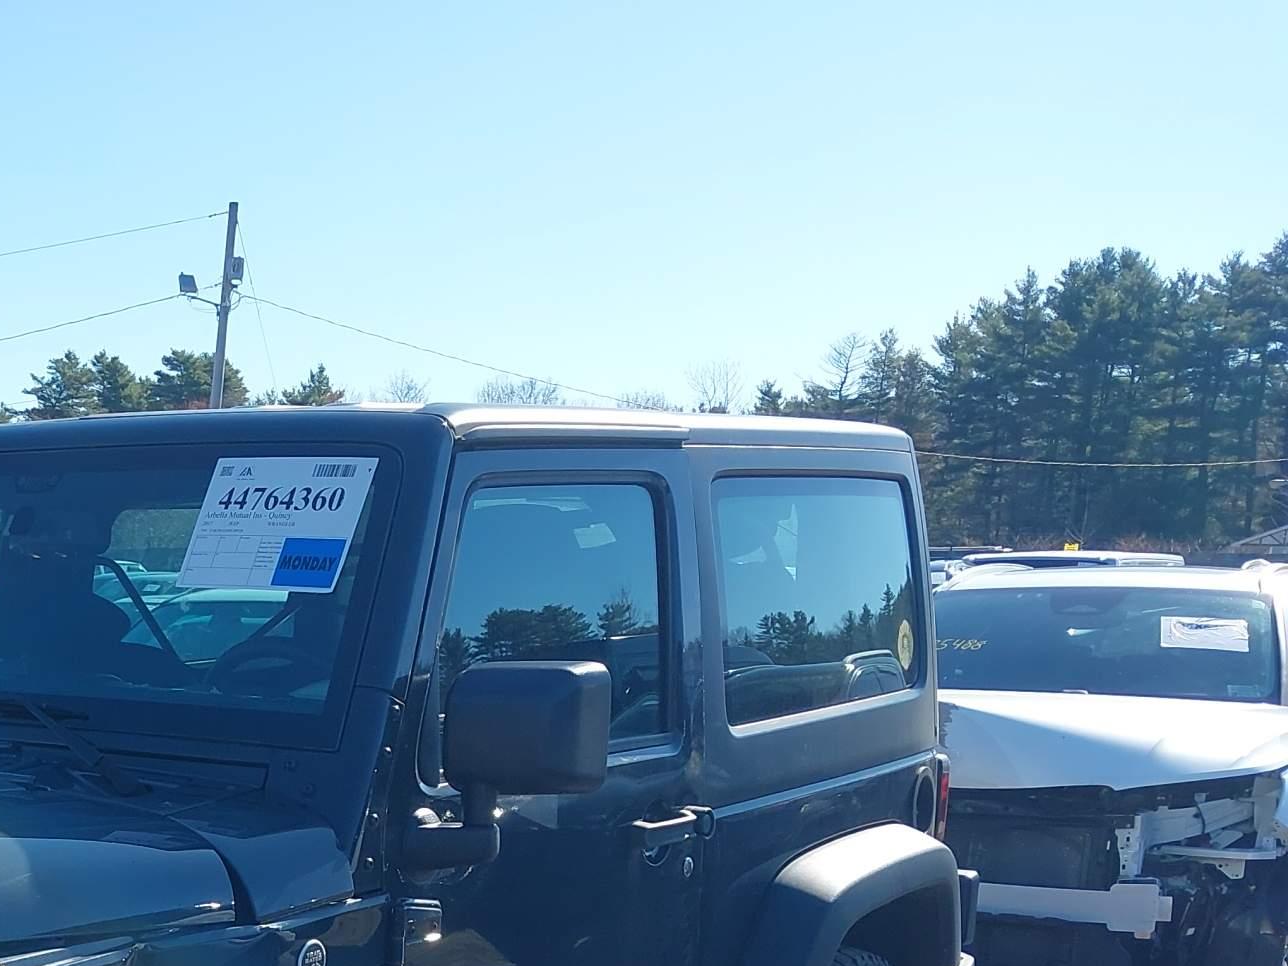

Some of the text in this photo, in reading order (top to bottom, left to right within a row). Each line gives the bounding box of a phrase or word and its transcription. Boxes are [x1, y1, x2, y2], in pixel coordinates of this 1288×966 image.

[218, 487, 346, 512] 44764360
[229, 511, 252, 519] Mutual
[268, 512, 291, 521] Quincy
[279, 555, 336, 572] MONDAY
[934, 638, 988, 651] 5488
